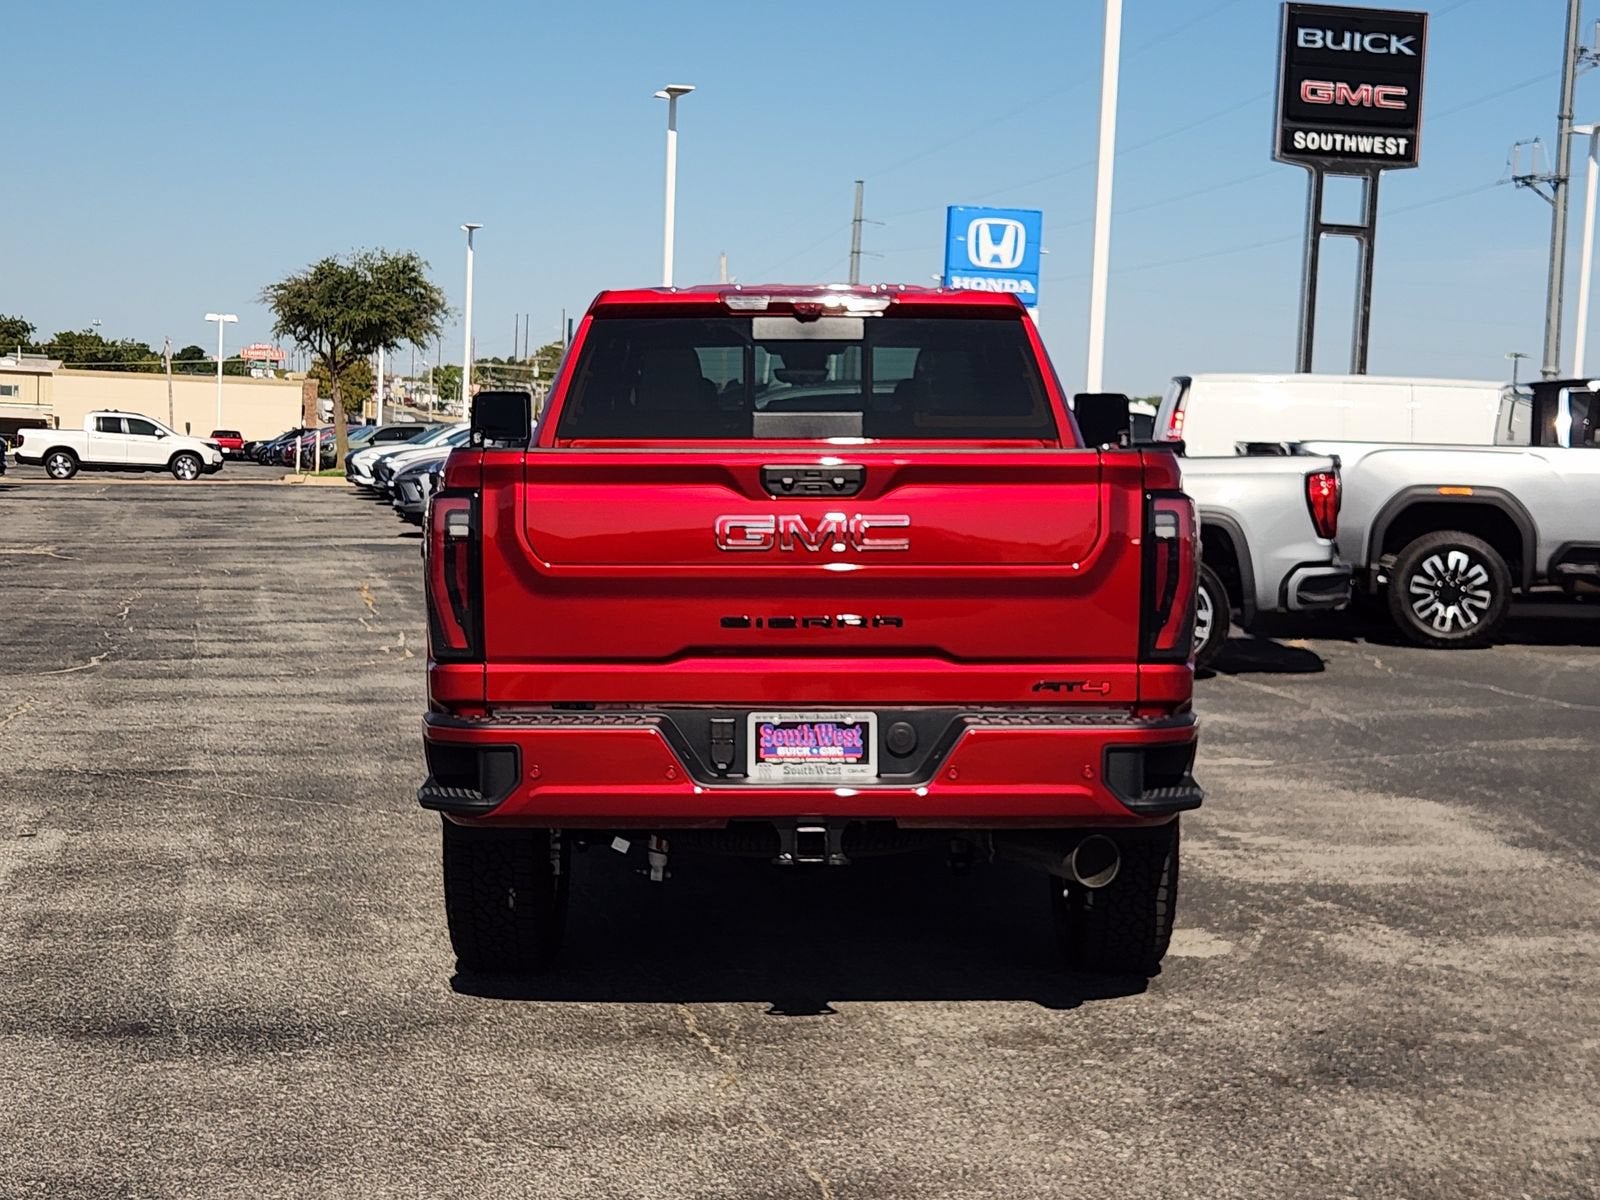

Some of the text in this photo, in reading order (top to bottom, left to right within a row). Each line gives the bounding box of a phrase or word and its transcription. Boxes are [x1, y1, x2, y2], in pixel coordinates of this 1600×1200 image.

[1297, 27, 1417, 56] BUICK
[1301, 79, 1409, 110] GMC
[1293, 131, 1409, 155] SOUTHWEST
[951, 276, 1036, 294] HONDA
[715, 512, 911, 552] GMC
[1031, 680, 1111, 696] AT4
